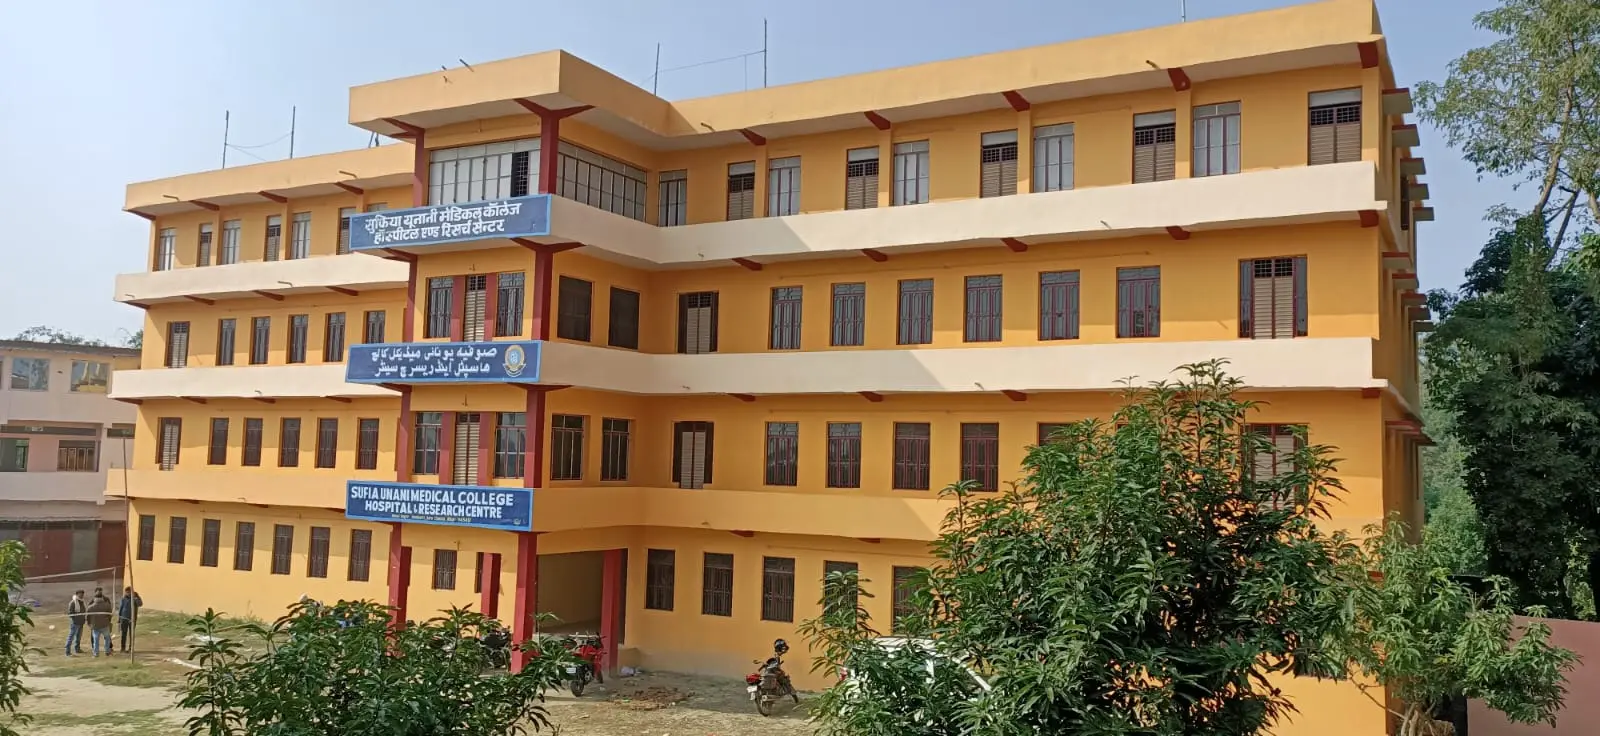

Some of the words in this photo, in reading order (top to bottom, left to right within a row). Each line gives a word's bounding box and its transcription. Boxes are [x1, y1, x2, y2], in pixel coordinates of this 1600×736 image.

[439, 206, 482, 222] मेडिकल
[483, 201, 522, 218] कॉलेज
[351, 486, 379, 500] SUFIA
[381, 488, 410, 501] UNANI
[411, 489, 457, 504] MEDICAL
[458, 492, 514, 506] COLLEGE
[365, 500, 412, 514] HOSPITAL
[418, 503, 465, 517] RESEARCH
[465, 506, 502, 519] CENTRE
